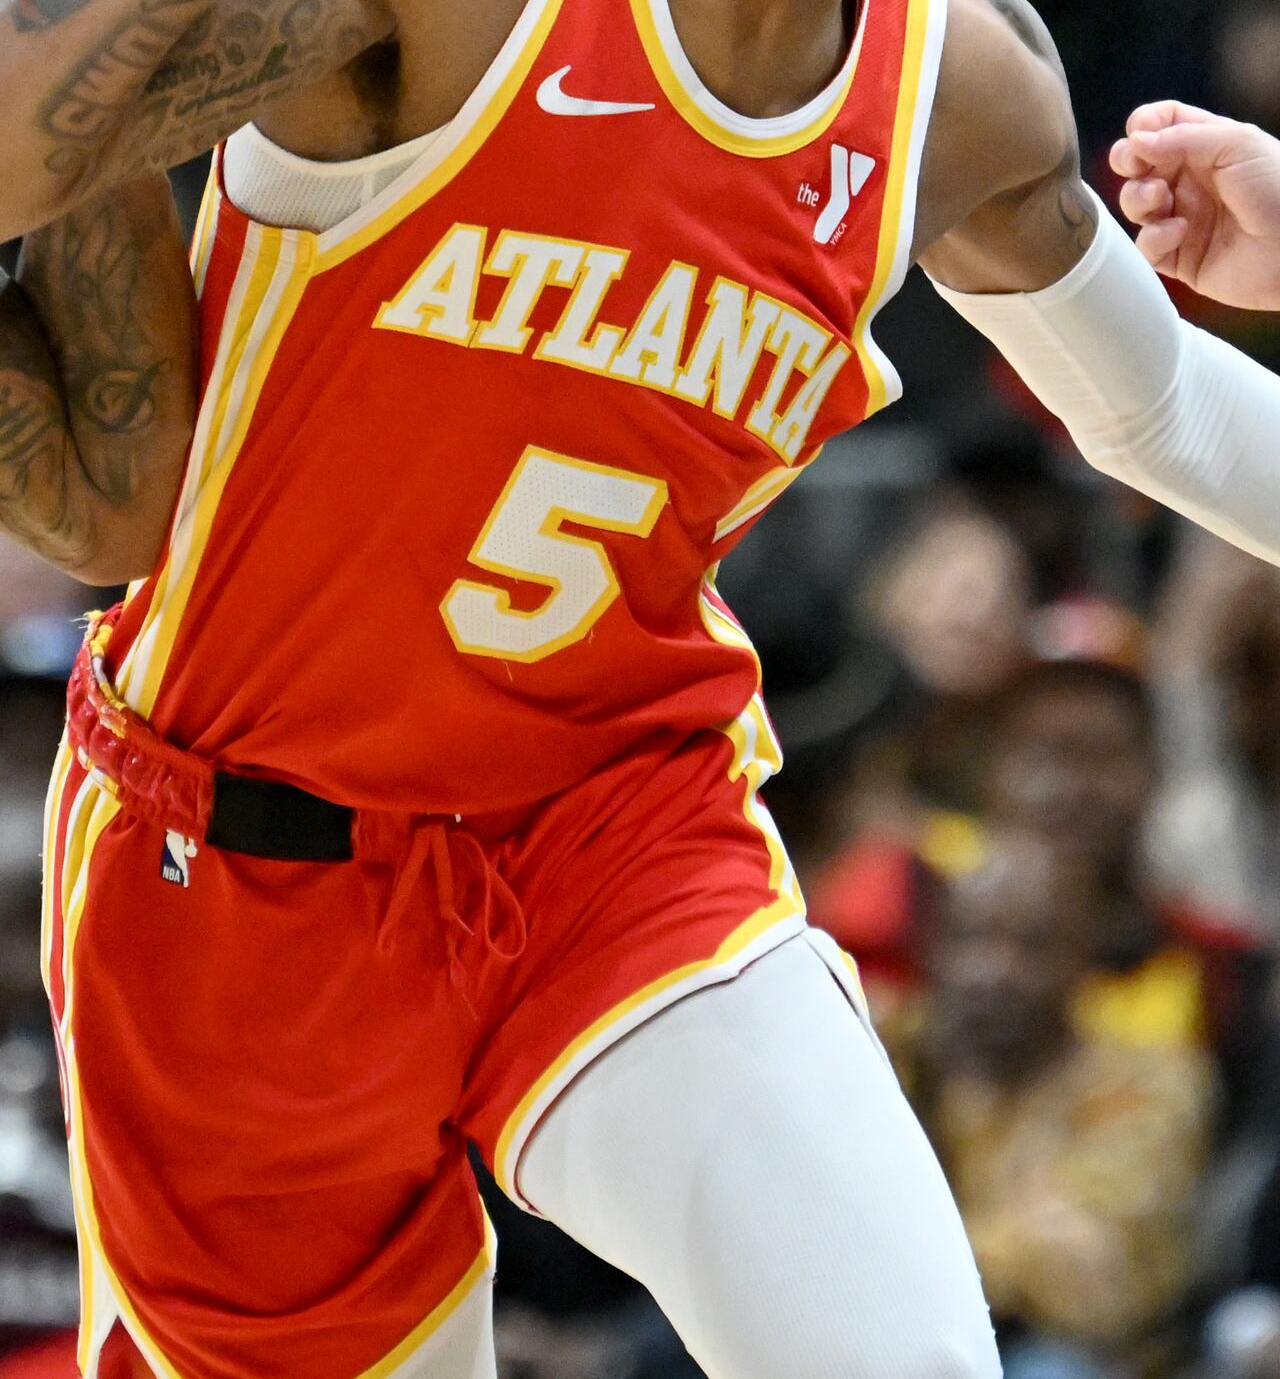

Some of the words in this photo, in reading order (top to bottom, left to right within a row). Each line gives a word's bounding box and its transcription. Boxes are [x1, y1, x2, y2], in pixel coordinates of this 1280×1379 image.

[796, 182, 820, 207] the
[829, 222, 848, 246] YMCA
[371, 221, 852, 468] ATLANTA
[439, 444, 668, 663] 5
[162, 865, 181, 883] NBA
